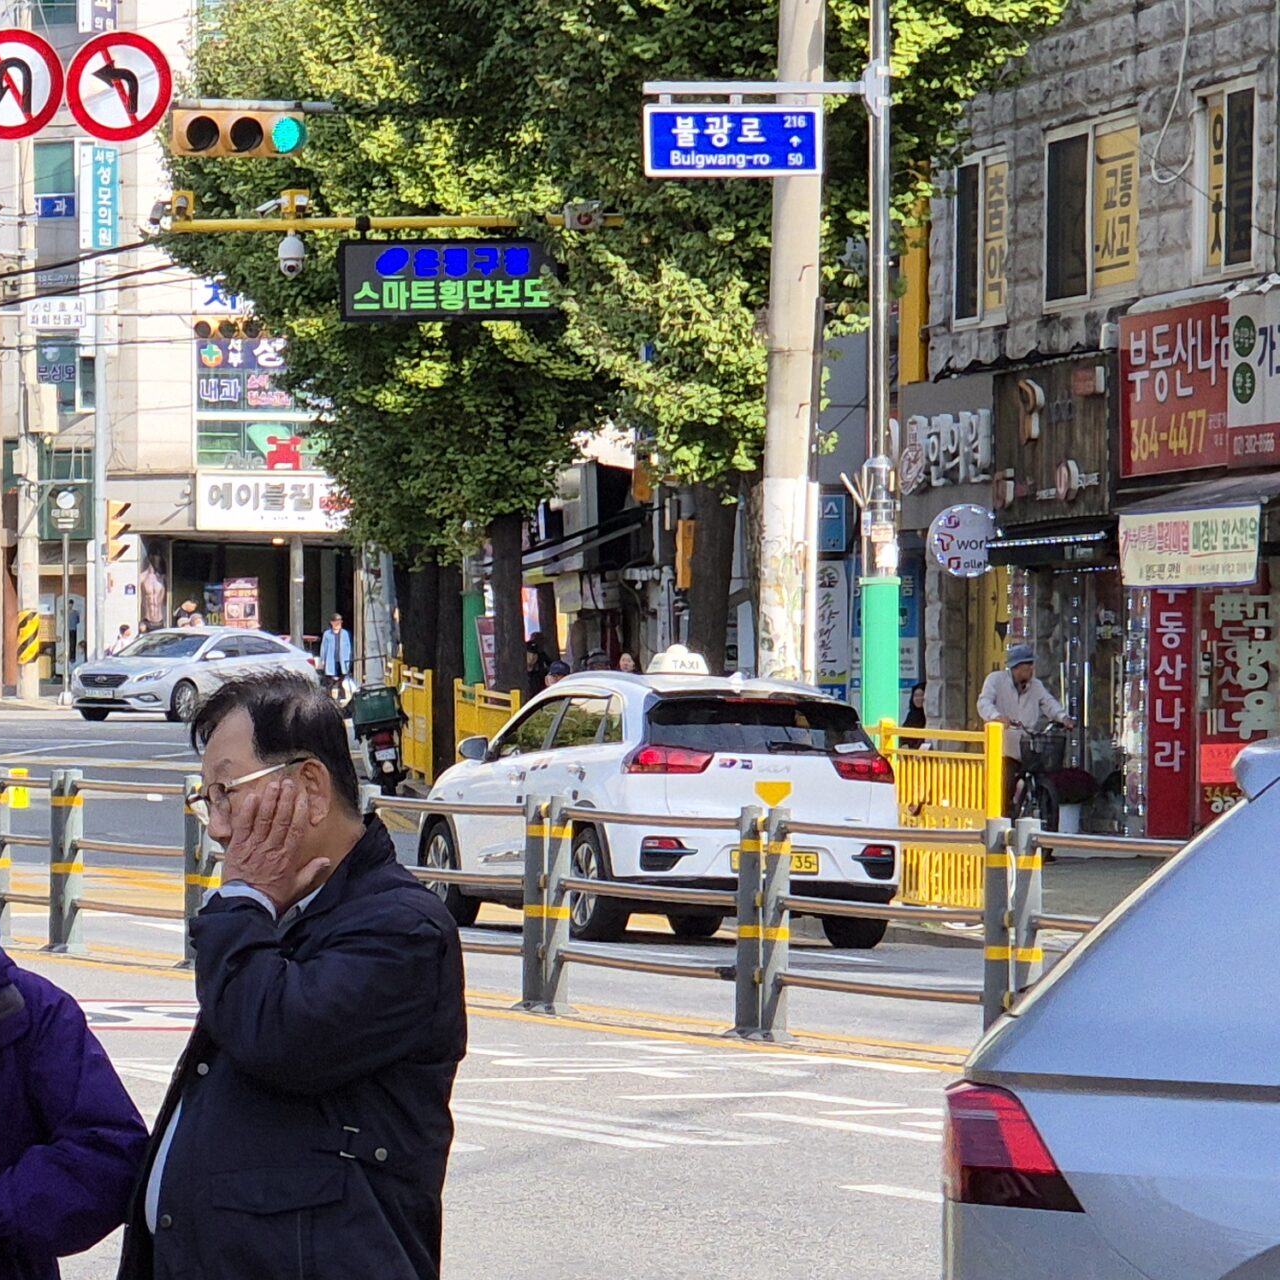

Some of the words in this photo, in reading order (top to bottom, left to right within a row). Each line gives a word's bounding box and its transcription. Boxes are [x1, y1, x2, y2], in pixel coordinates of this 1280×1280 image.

[671, 117, 767, 146] 불광로
[784, 116, 806, 128] 216
[670, 150, 770, 168] Bulgwang-ro
[787, 153, 803, 166] 50
[96, 167, 114, 247] 성모의원
[353, 278, 551, 311] 스마트횡단보도
[37, 364, 76, 383] 부성모
[200, 378, 240, 402] 내과
[1130, 408, 1207, 463] 364-4477
[208, 482, 315, 512] 에이블짐
[956, 537, 987, 550] wor
[671, 660, 700, 670] TAXI
